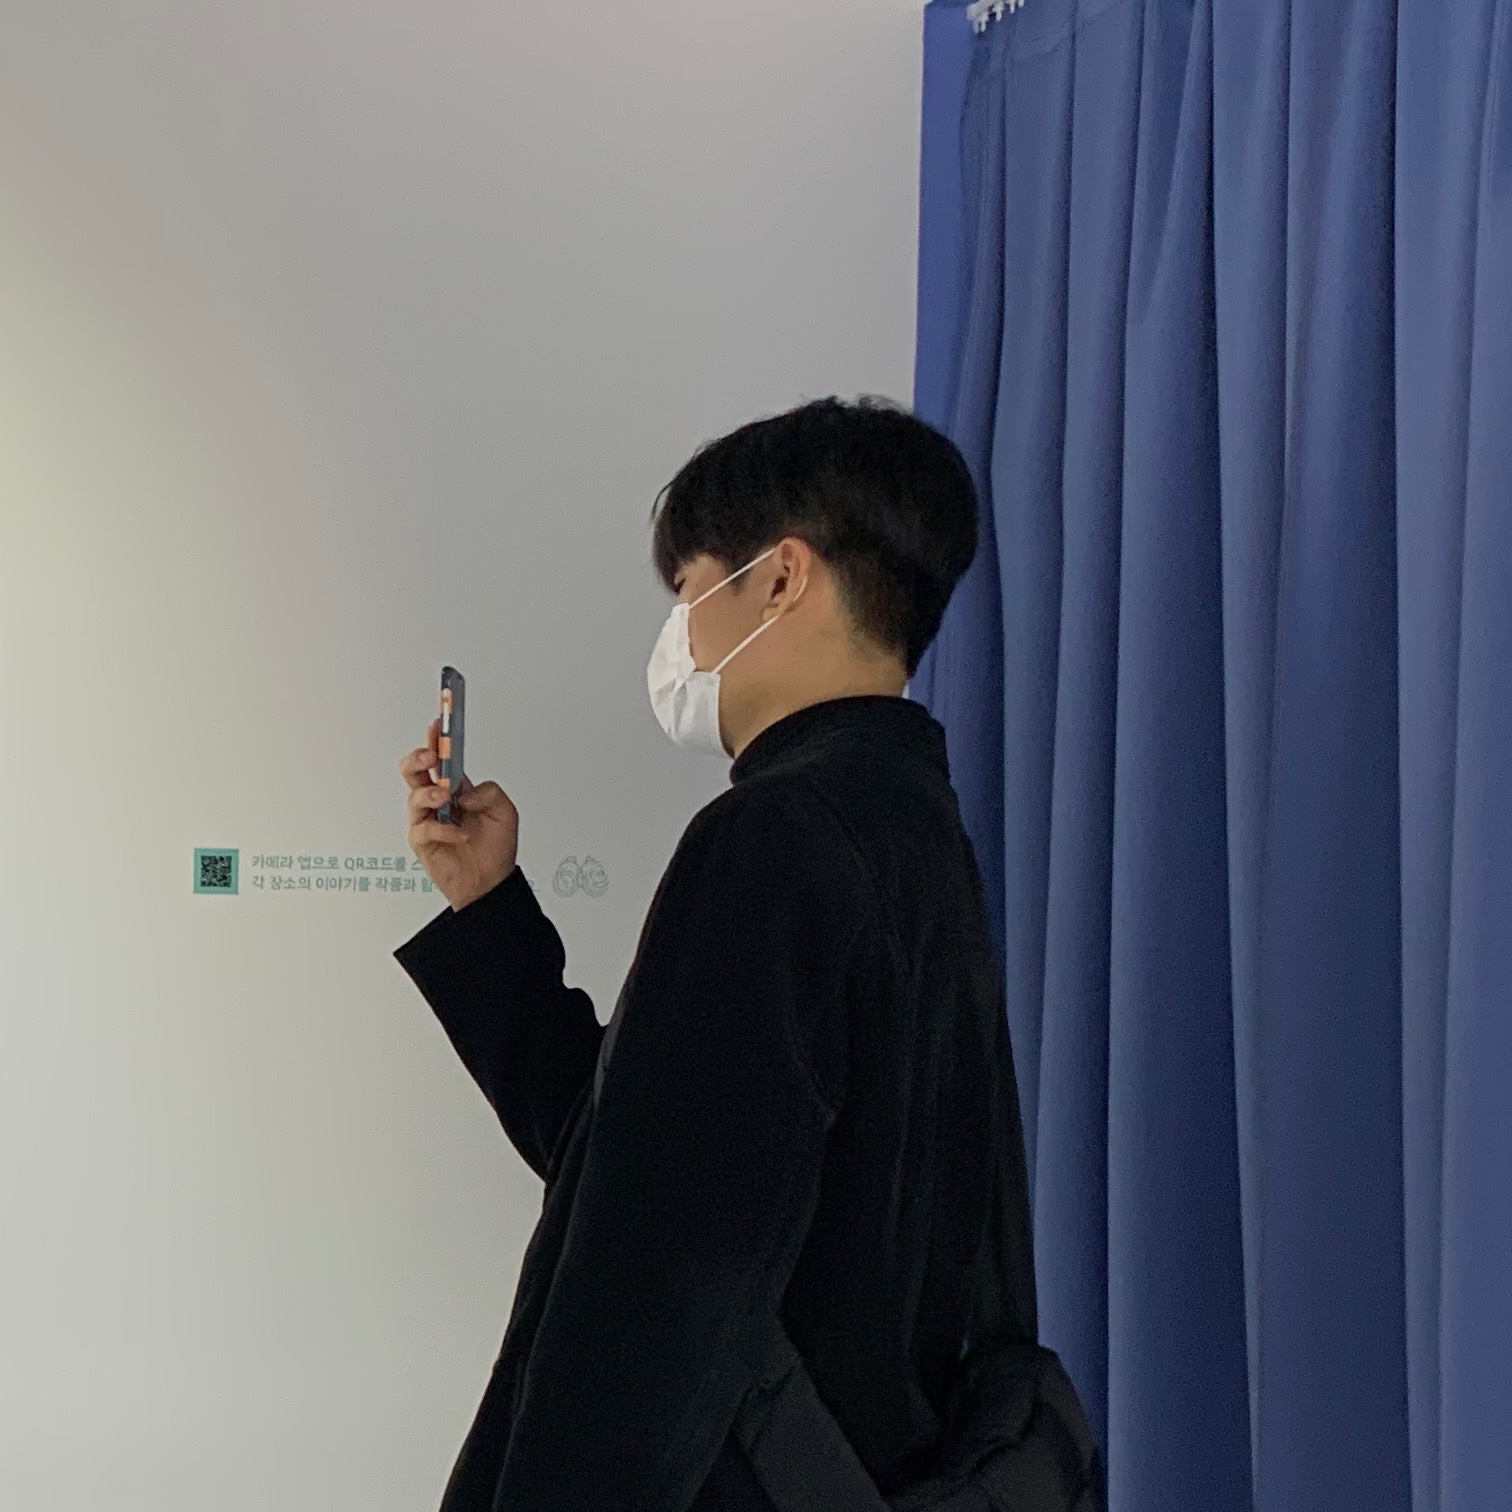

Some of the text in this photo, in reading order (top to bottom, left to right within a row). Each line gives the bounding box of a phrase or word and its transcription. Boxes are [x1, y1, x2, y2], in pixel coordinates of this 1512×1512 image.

[251, 854, 293, 869] 카메라
[297, 855, 340, 870] 앱으로
[344, 856, 406, 872] QR코드를
[252, 875, 264, 890] 각
[270, 875, 311, 891] 장소의
[316, 876, 371, 892] 이야기를
